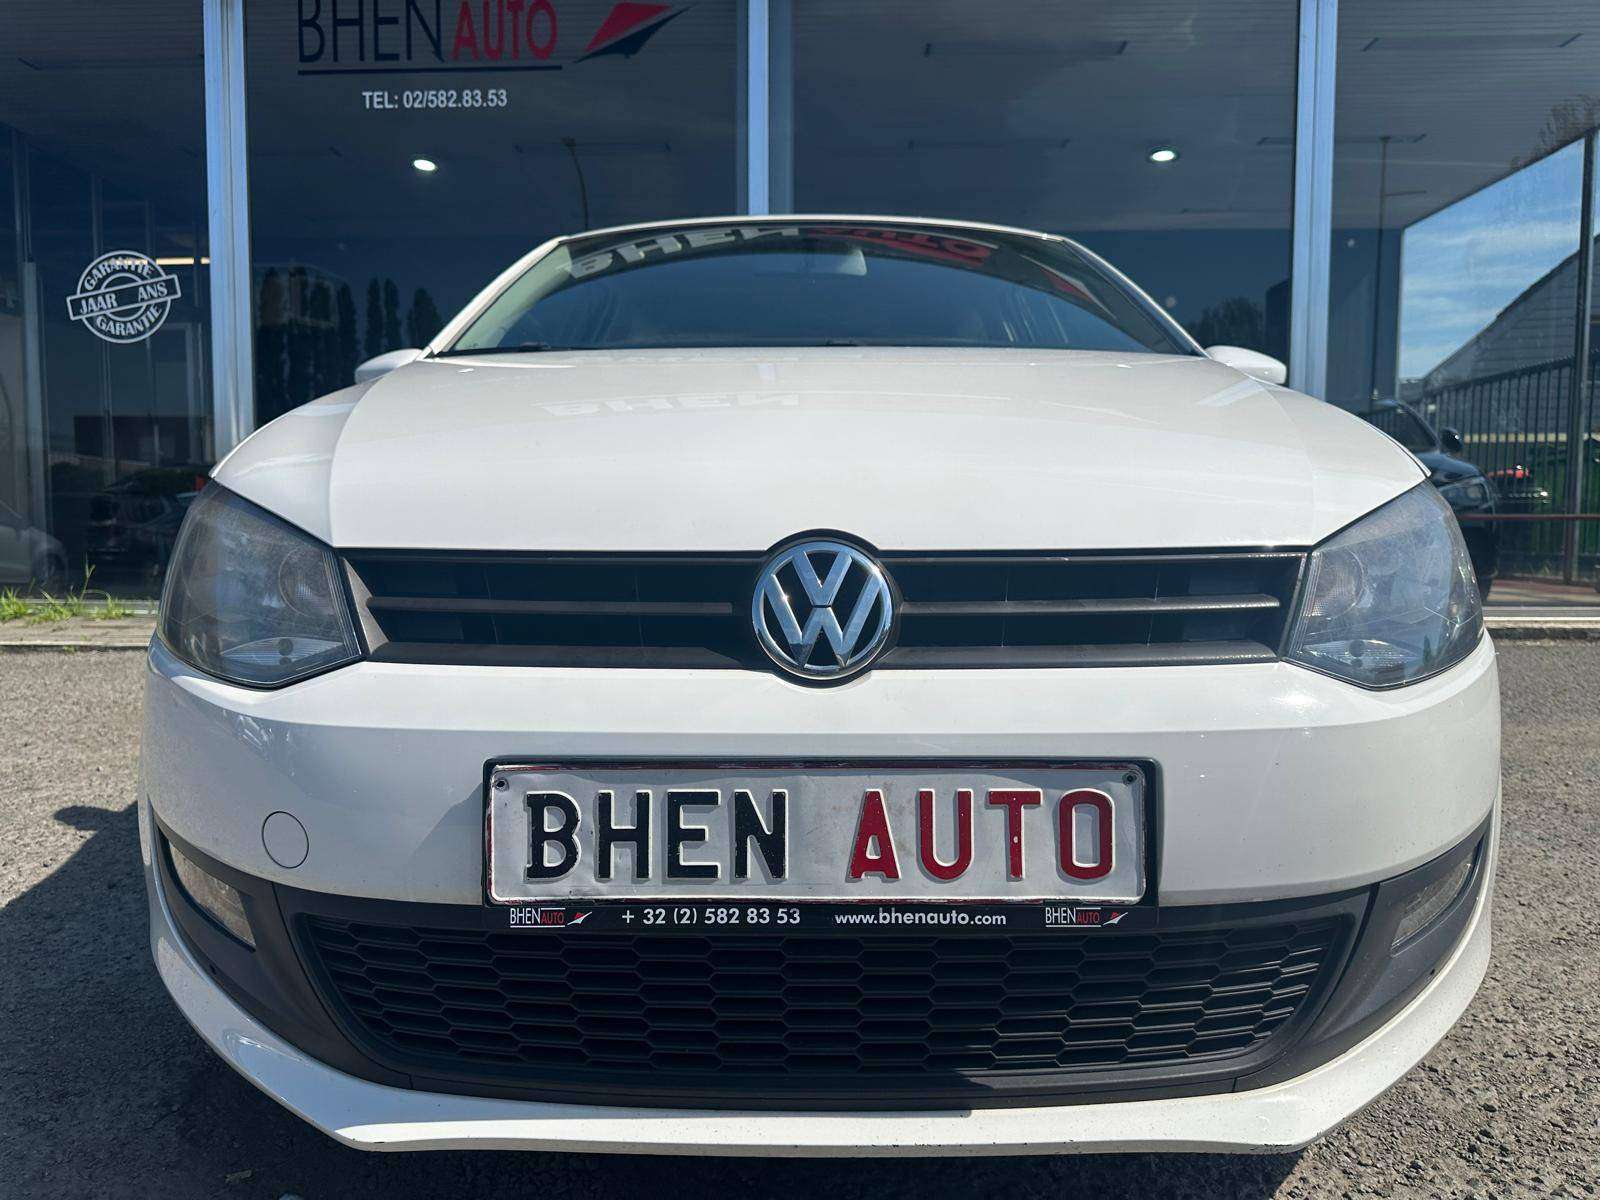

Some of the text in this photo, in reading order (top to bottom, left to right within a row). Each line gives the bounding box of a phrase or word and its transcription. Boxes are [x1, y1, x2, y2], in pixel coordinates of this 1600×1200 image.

[298, 0, 558, 63] BHEN AUTO
[362, 89, 508, 109] TEL: 02/582.83.53
[84, 257, 154, 291] GARANTIE
[80, 282, 168, 315] JAAR ANS
[96, 305, 161, 336] GARANTIE
[524, 787, 1114, 881] BHEN AUTO
[673, 907, 697, 926] (2)
[704, 908, 740, 924] 582
[746, 908, 770, 924] 83
[776, 907, 801, 924] 53
[834, 907, 1007, 926] www.bhenauto.com
